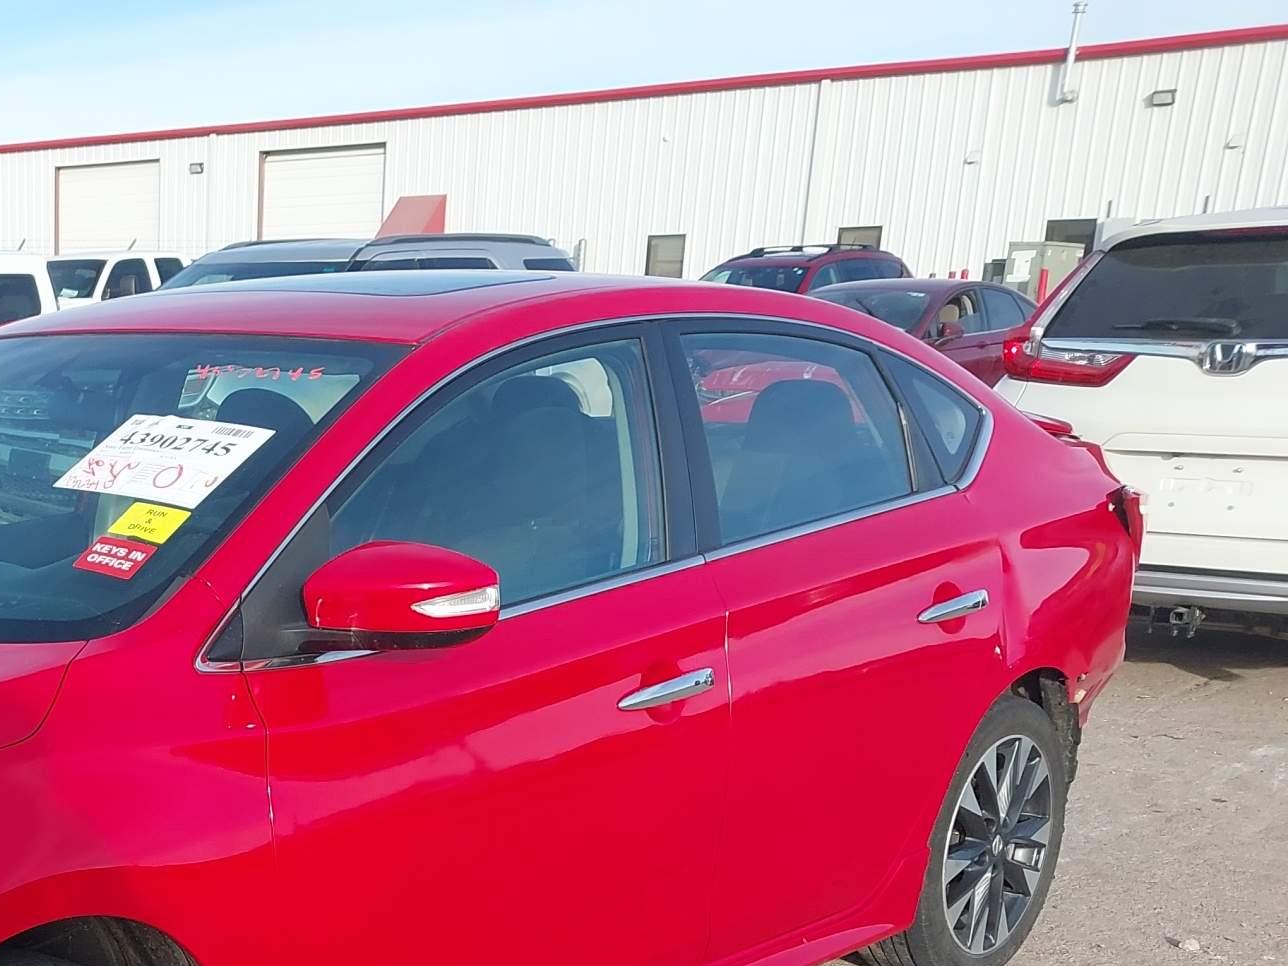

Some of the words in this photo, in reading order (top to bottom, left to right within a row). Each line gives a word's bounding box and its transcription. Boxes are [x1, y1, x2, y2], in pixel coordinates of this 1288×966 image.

[120, 430, 239, 457] 43902745
[145, 508, 169, 517] RUN
[128, 523, 157, 534] DRIVE
[92, 543, 129, 557] KEYS
[129, 550, 147, 561] IN
[86, 554, 134, 571] OFFICE
